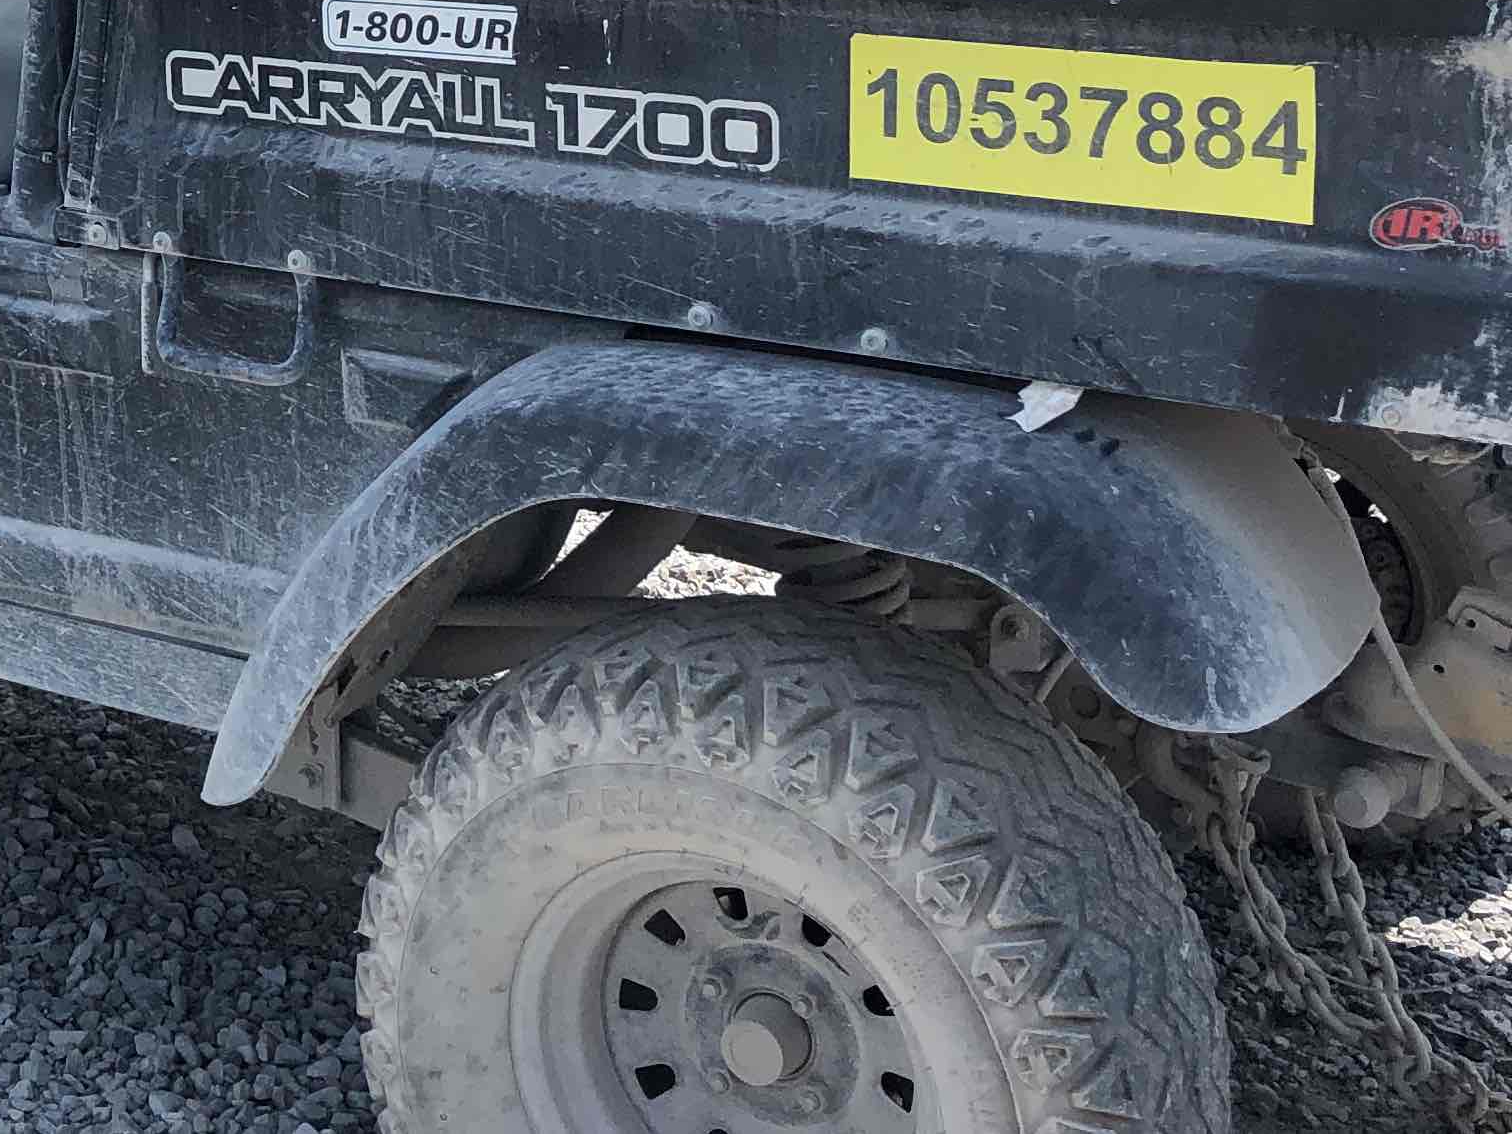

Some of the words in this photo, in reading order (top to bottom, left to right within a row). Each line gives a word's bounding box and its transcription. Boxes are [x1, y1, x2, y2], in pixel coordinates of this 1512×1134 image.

[335, 9, 513, 52] 1-800-UR
[167, 50, 536, 148] CARRYALL
[546, 83, 780, 173] 1700
[866, 68, 1307, 176] 10537884
